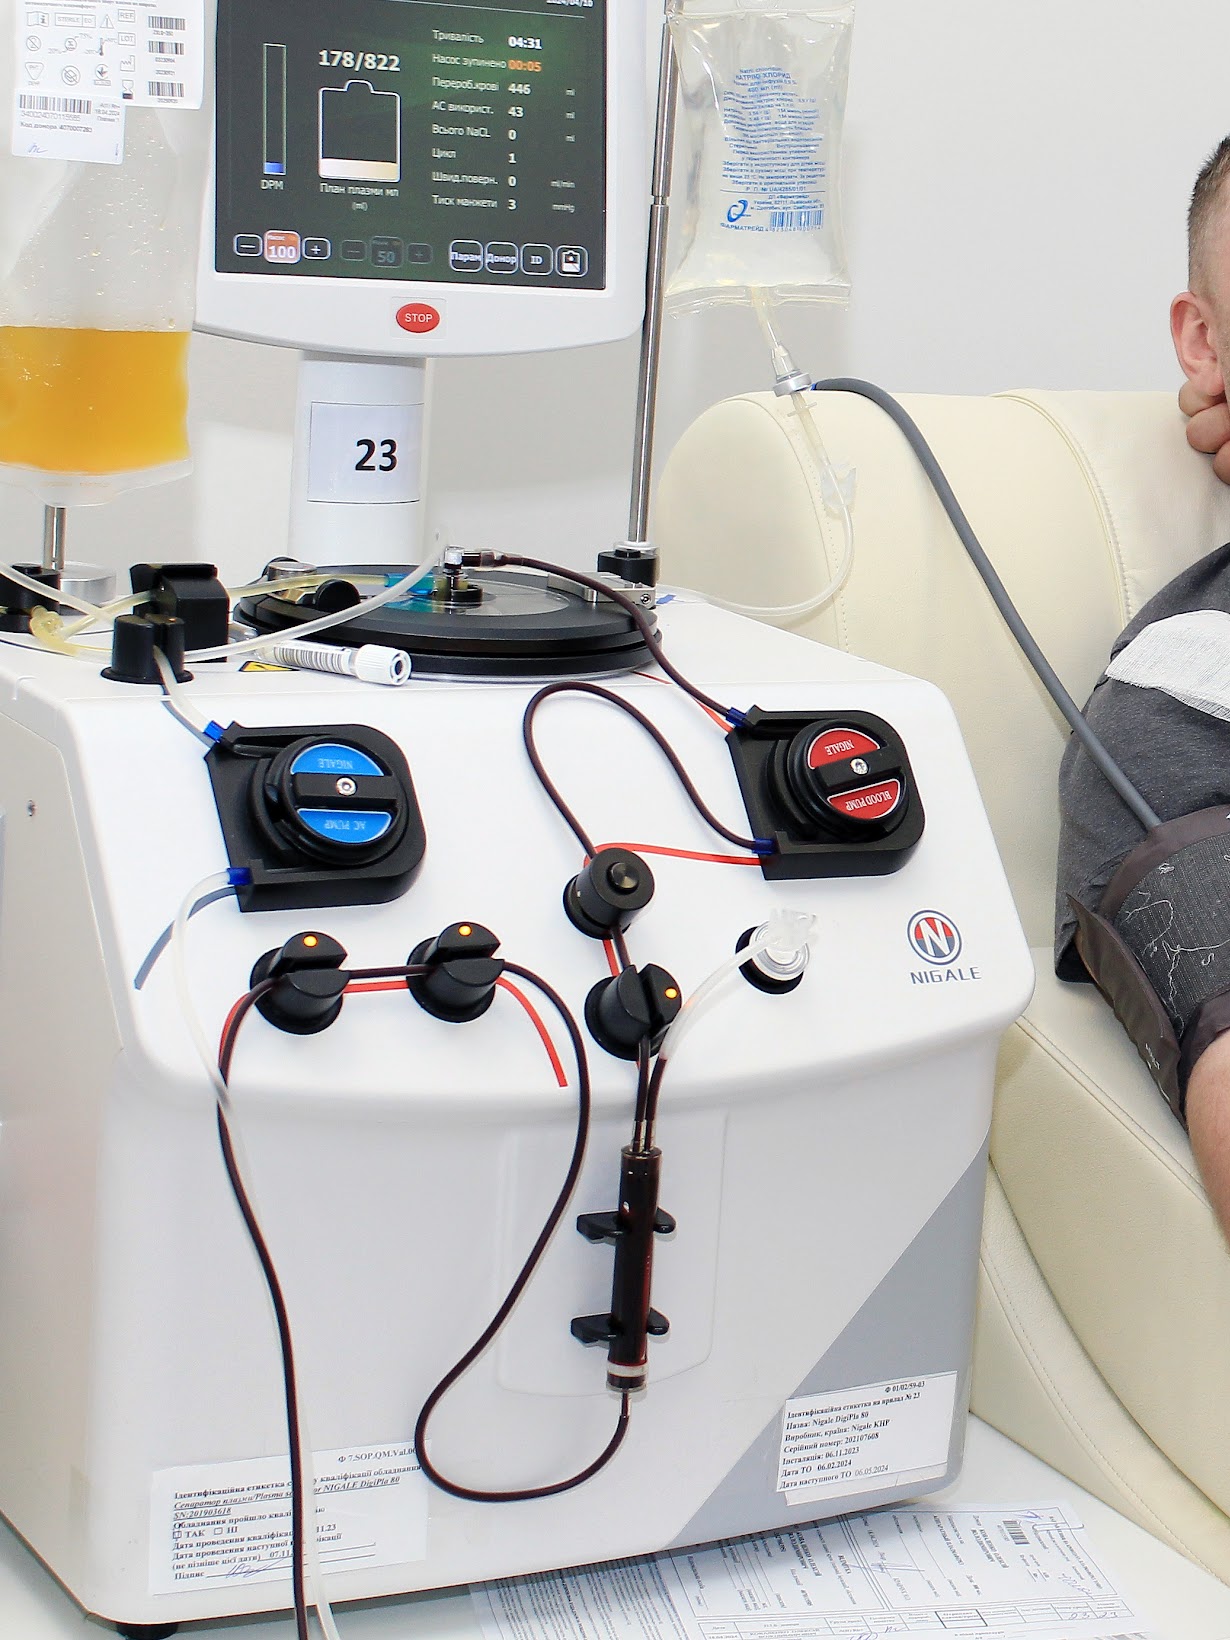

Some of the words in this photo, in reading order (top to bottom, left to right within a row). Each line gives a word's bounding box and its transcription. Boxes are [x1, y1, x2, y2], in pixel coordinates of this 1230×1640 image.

[432, 29, 485, 44] Тривалість
[508, 36, 542, 50] 04:31
[318, 49, 400, 73] 178/822
[432, 53, 460, 65] Насос
[462, 57, 506, 69] зупинено
[508, 60, 542, 72] 00:05
[432, 76, 499, 92] Перероб.крові
[508, 83, 531, 95] 446
[448, 103, 494, 114] використ.
[508, 106, 524, 117] 43
[432, 123, 464, 136] Всього
[508, 129, 517, 140] 0
[432, 148, 457, 159] Цикл
[508, 153, 517, 163] 1
[260, 180, 284, 190] DPM
[320, 182, 345, 194] План
[348, 185, 383, 196] плазми
[508, 176, 517, 187] 0
[432, 194, 454, 205] Тиск
[456, 197, 498, 208] манжети
[508, 199, 517, 210] 3
[268, 245, 296, 259] 100
[377, 251, 395, 263] 50
[451, 251, 482, 262] Парам
[486, 252, 517, 264] Донор
[531, 255, 542, 265] ID
[405, 313, 433, 323] STOP
[355, 438, 398, 472] 23
[825, 739, 855, 756] NIGALE
[318, 758, 353, 769] NIGALE
[846, 795, 867, 811] PUMP
[867, 790, 892, 806] BLOOD
[324, 819, 350, 830] PUMP
[355, 820, 366, 830] AC
[910, 966, 981, 985] NIGALE
[788, 1405, 841, 1419] Ідентифікаційна
[843, 1401, 871, 1410] етикетка
[882, 1396, 904, 1405] прилад
[786, 1422, 811, 1430] Назва:
[813, 1416, 834, 1426] Nigale
[835, 1413, 859, 1423] DigiPla
[785, 1432, 823, 1442] Виробник,
[824, 1426, 850, 1437] країна:
[851, 1422, 872, 1431] Nigale
[784, 1442, 818, 1453] Серійний
[819, 1439, 843, 1449] номер:
[782, 1455, 824, 1465] Інсталяція:
[825, 1446, 860, 1458] 06.11.2023
[781, 1469, 798, 1478] Дата
[801, 1465, 812, 1474] ТО
[817, 1459, 852, 1471] 06.02.2024
[780, 1480, 797, 1489] Дата
[799, 1474, 838, 1486] наступного
[841, 1471, 852, 1479] ТО
[854, 1464, 888, 1476] 06.05.2024
[175, 1486, 245, 1500] Ідентифікаційна
[246, 1480, 285, 1491] етикетка
[320, 1469, 372, 1482] кваліфікації
[323, 1481, 359, 1492] NIGALE
[360, 1477, 388, 1488] DigiPla
[173, 1519, 226, 1529] Обладнання
[229, 1513, 266, 1524] пройшло
[185, 1530, 205, 1538] ТАК
[172, 1542, 193, 1551] Дата
[196, 1536, 245, 1549] проведення
[172, 1552, 193, 1560] Дата
[195, 1547, 244, 1559] проведення
[247, 1541, 288, 1551] наступної
[187, 1560, 219, 1569] пізніше
[174, 1571, 204, 1580] Підпис
